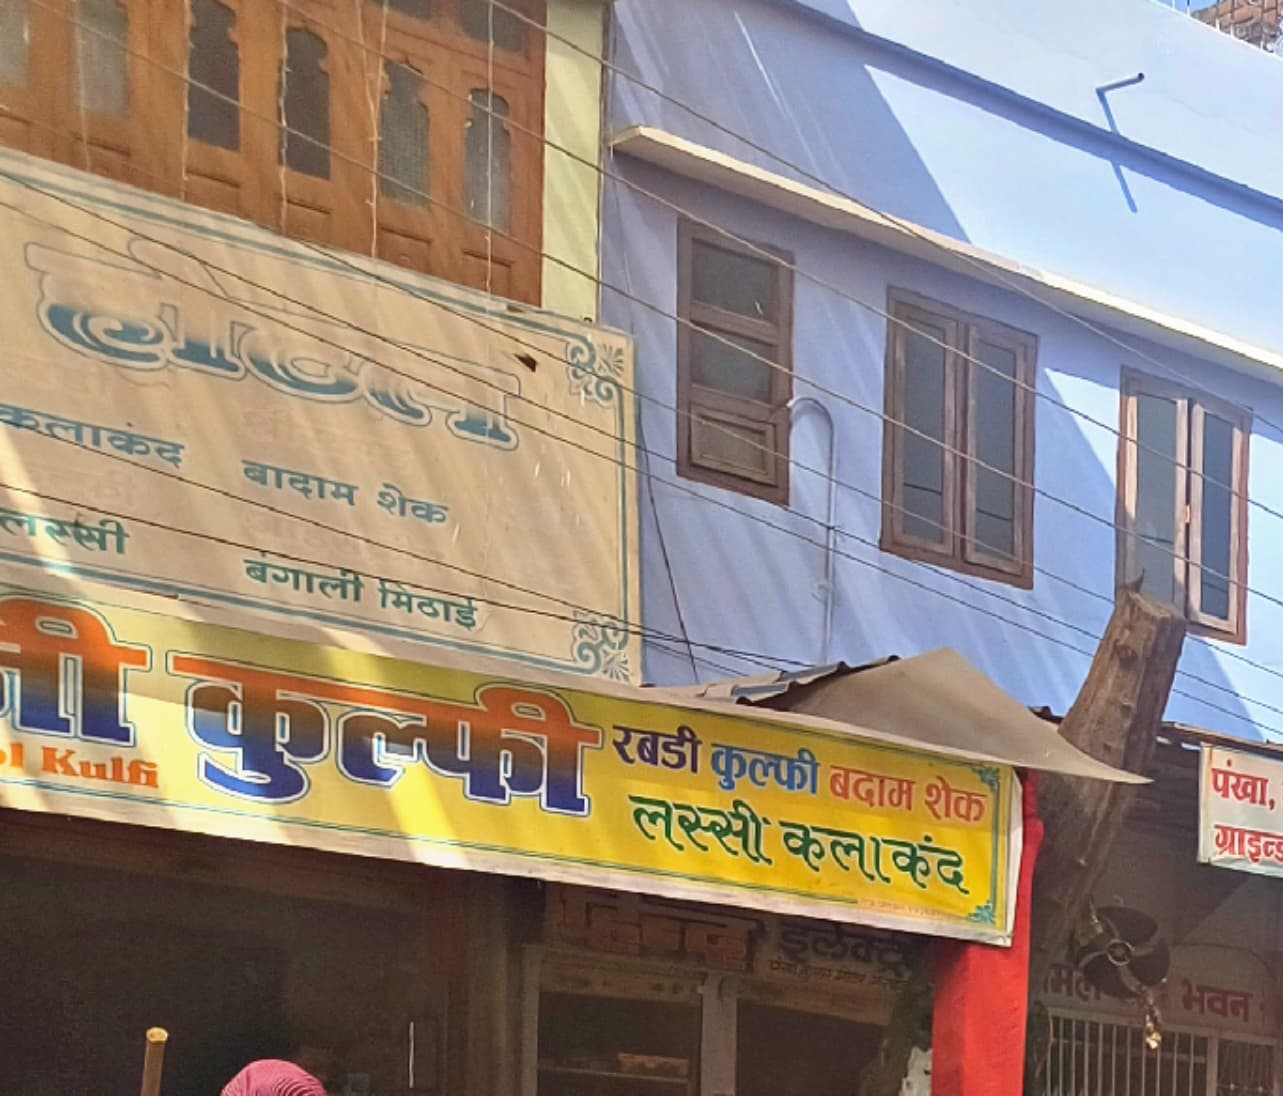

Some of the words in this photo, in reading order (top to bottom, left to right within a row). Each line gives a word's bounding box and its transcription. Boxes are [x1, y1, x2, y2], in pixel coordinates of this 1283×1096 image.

[243, 459, 358, 506] बादाम
[377, 484, 450, 527] शेक
[244, 552, 365, 603] बंगाली
[378, 578, 480, 632] मिठाई
[42, 746, 159, 788] Kulfi
[167, 651, 603, 817] कुल्फी
[710, 742, 820, 796] कुल्फी
[830, 765, 917, 812] बदाम
[924, 774, 986, 824] शेक
[628, 794, 773, 867] लस्सी
[779, 820, 970, 895] कलाकंद
[1181, 977, 1254, 1023] भवन
